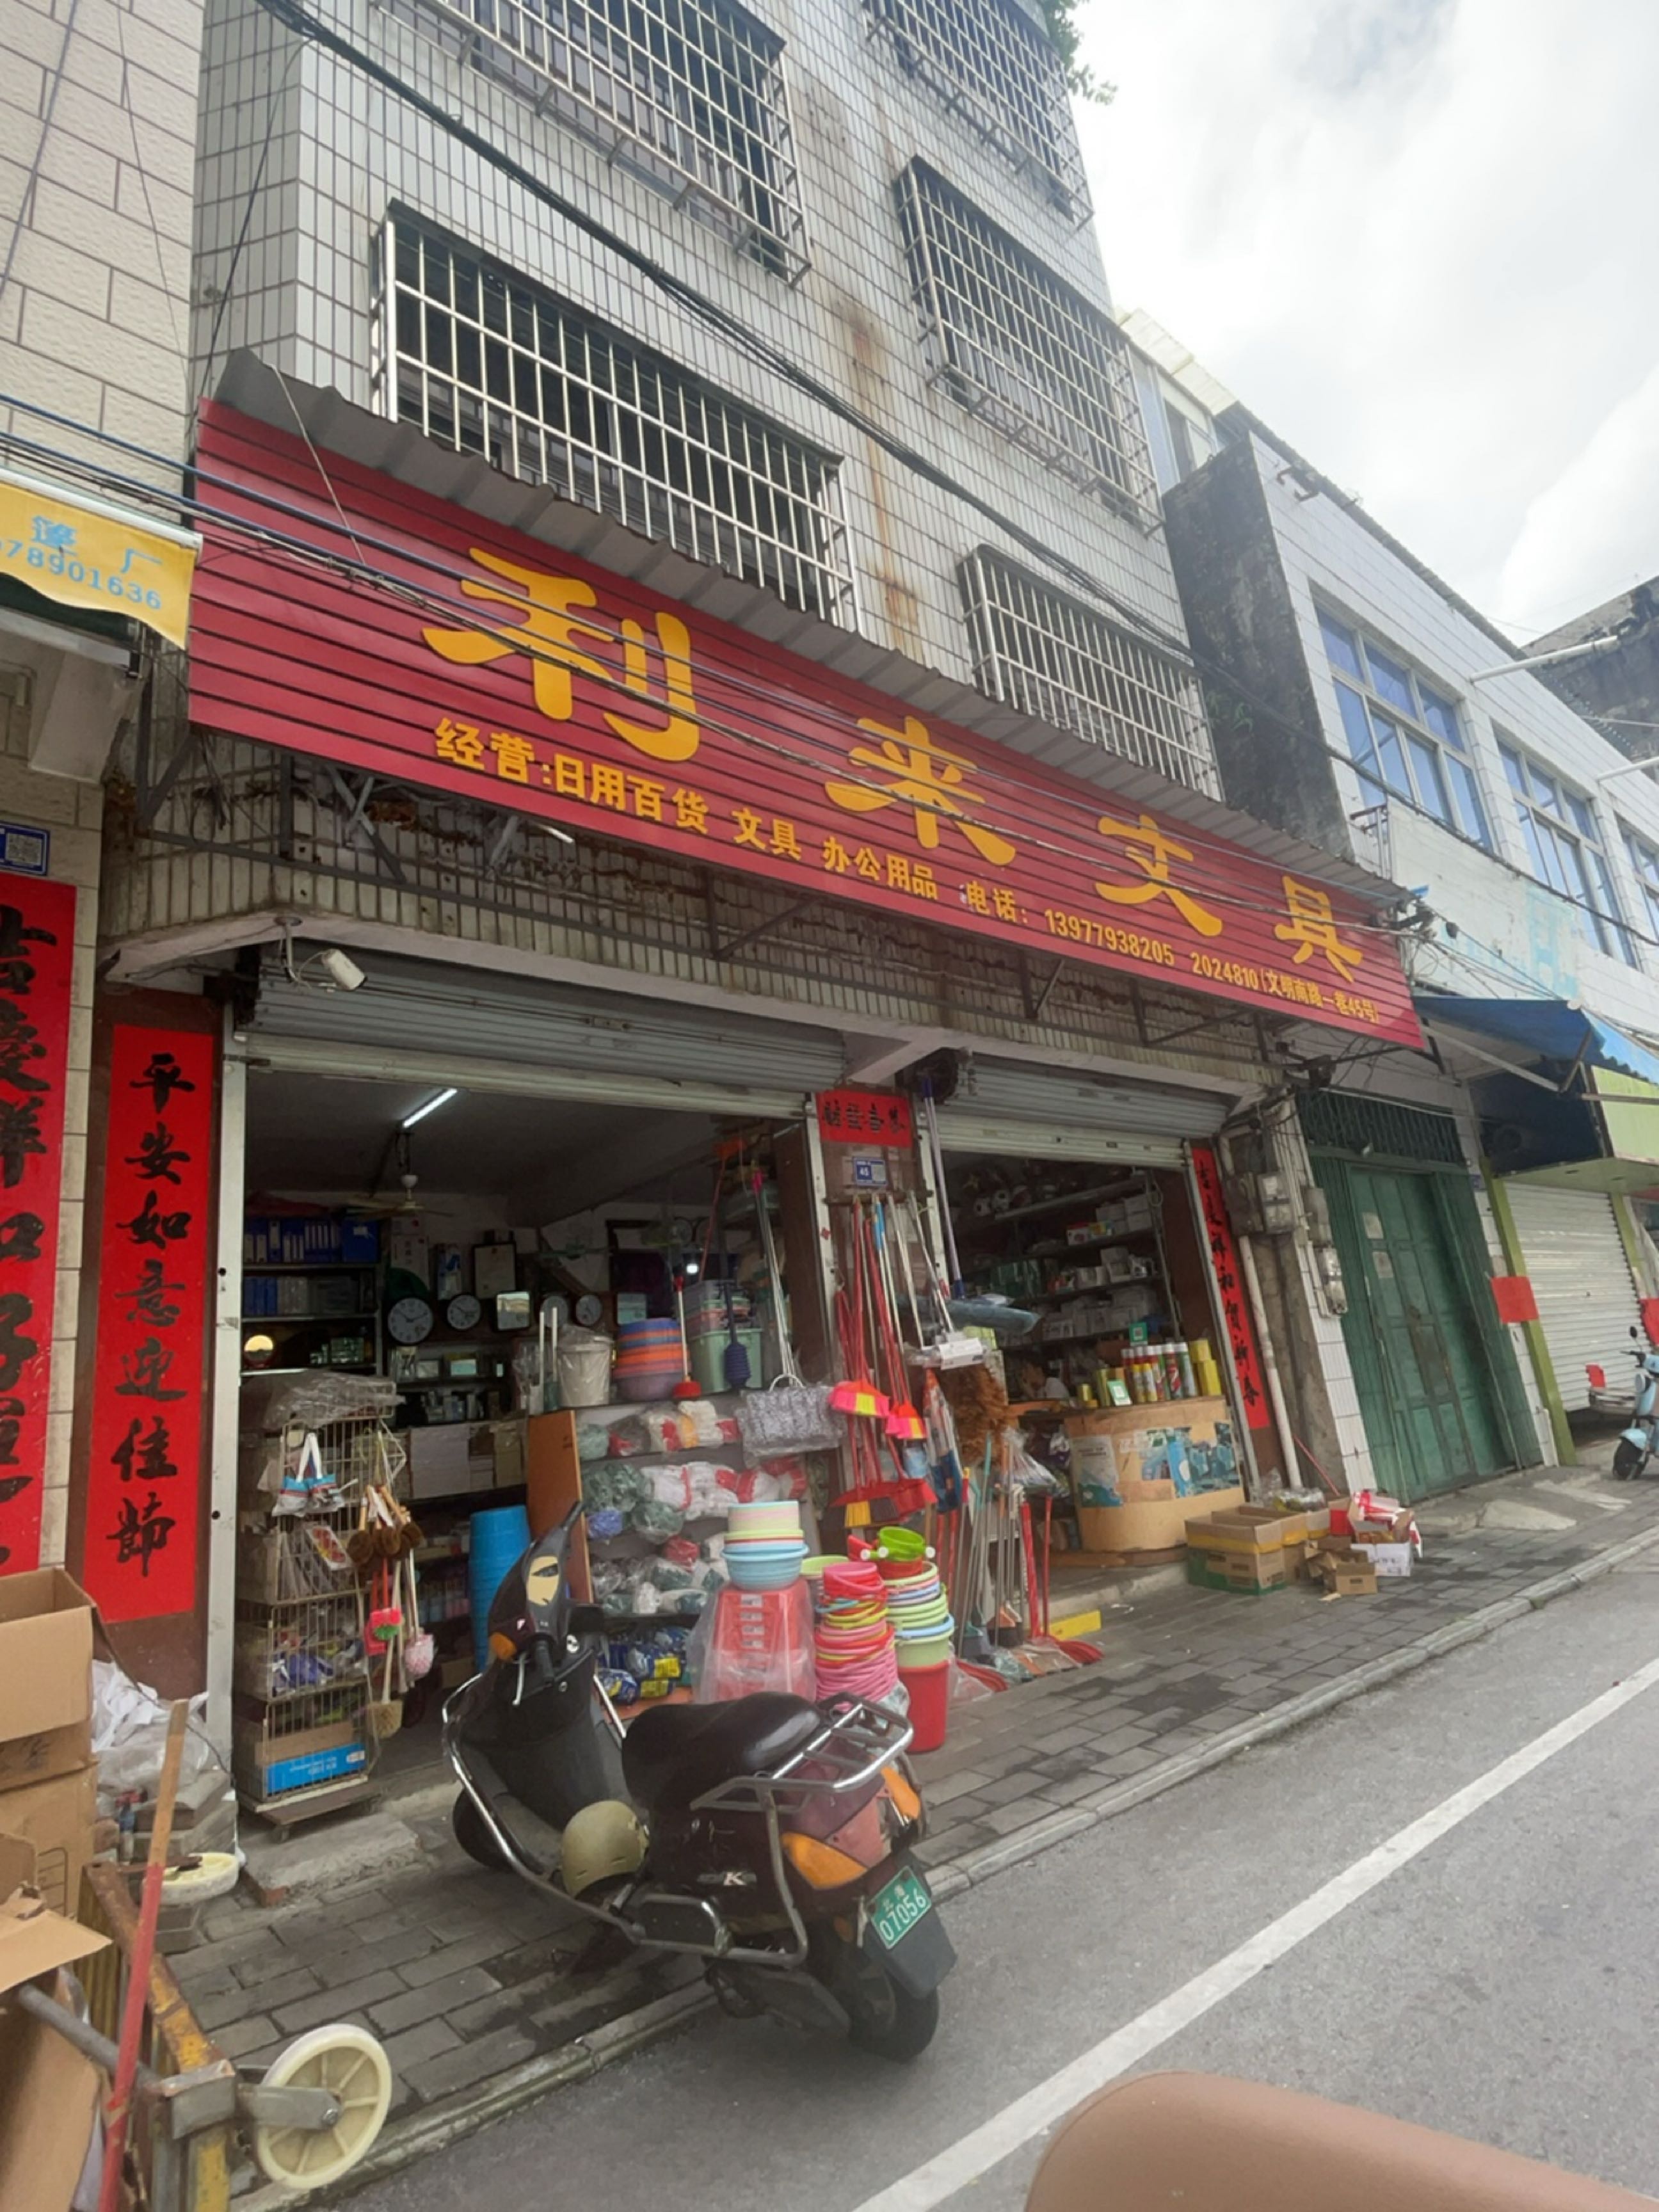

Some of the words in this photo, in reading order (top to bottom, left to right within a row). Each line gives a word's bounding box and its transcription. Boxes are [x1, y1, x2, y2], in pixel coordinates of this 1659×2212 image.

[421, 547, 1363, 983] 利来文具
[731, 807, 802, 861] 文具
[823, 836, 938, 900] 办公用品
[1045, 909, 1175, 967] 13977938205
[1190, 952, 1258, 991] 2024810
[879, 1887, 926, 1941] 07056
